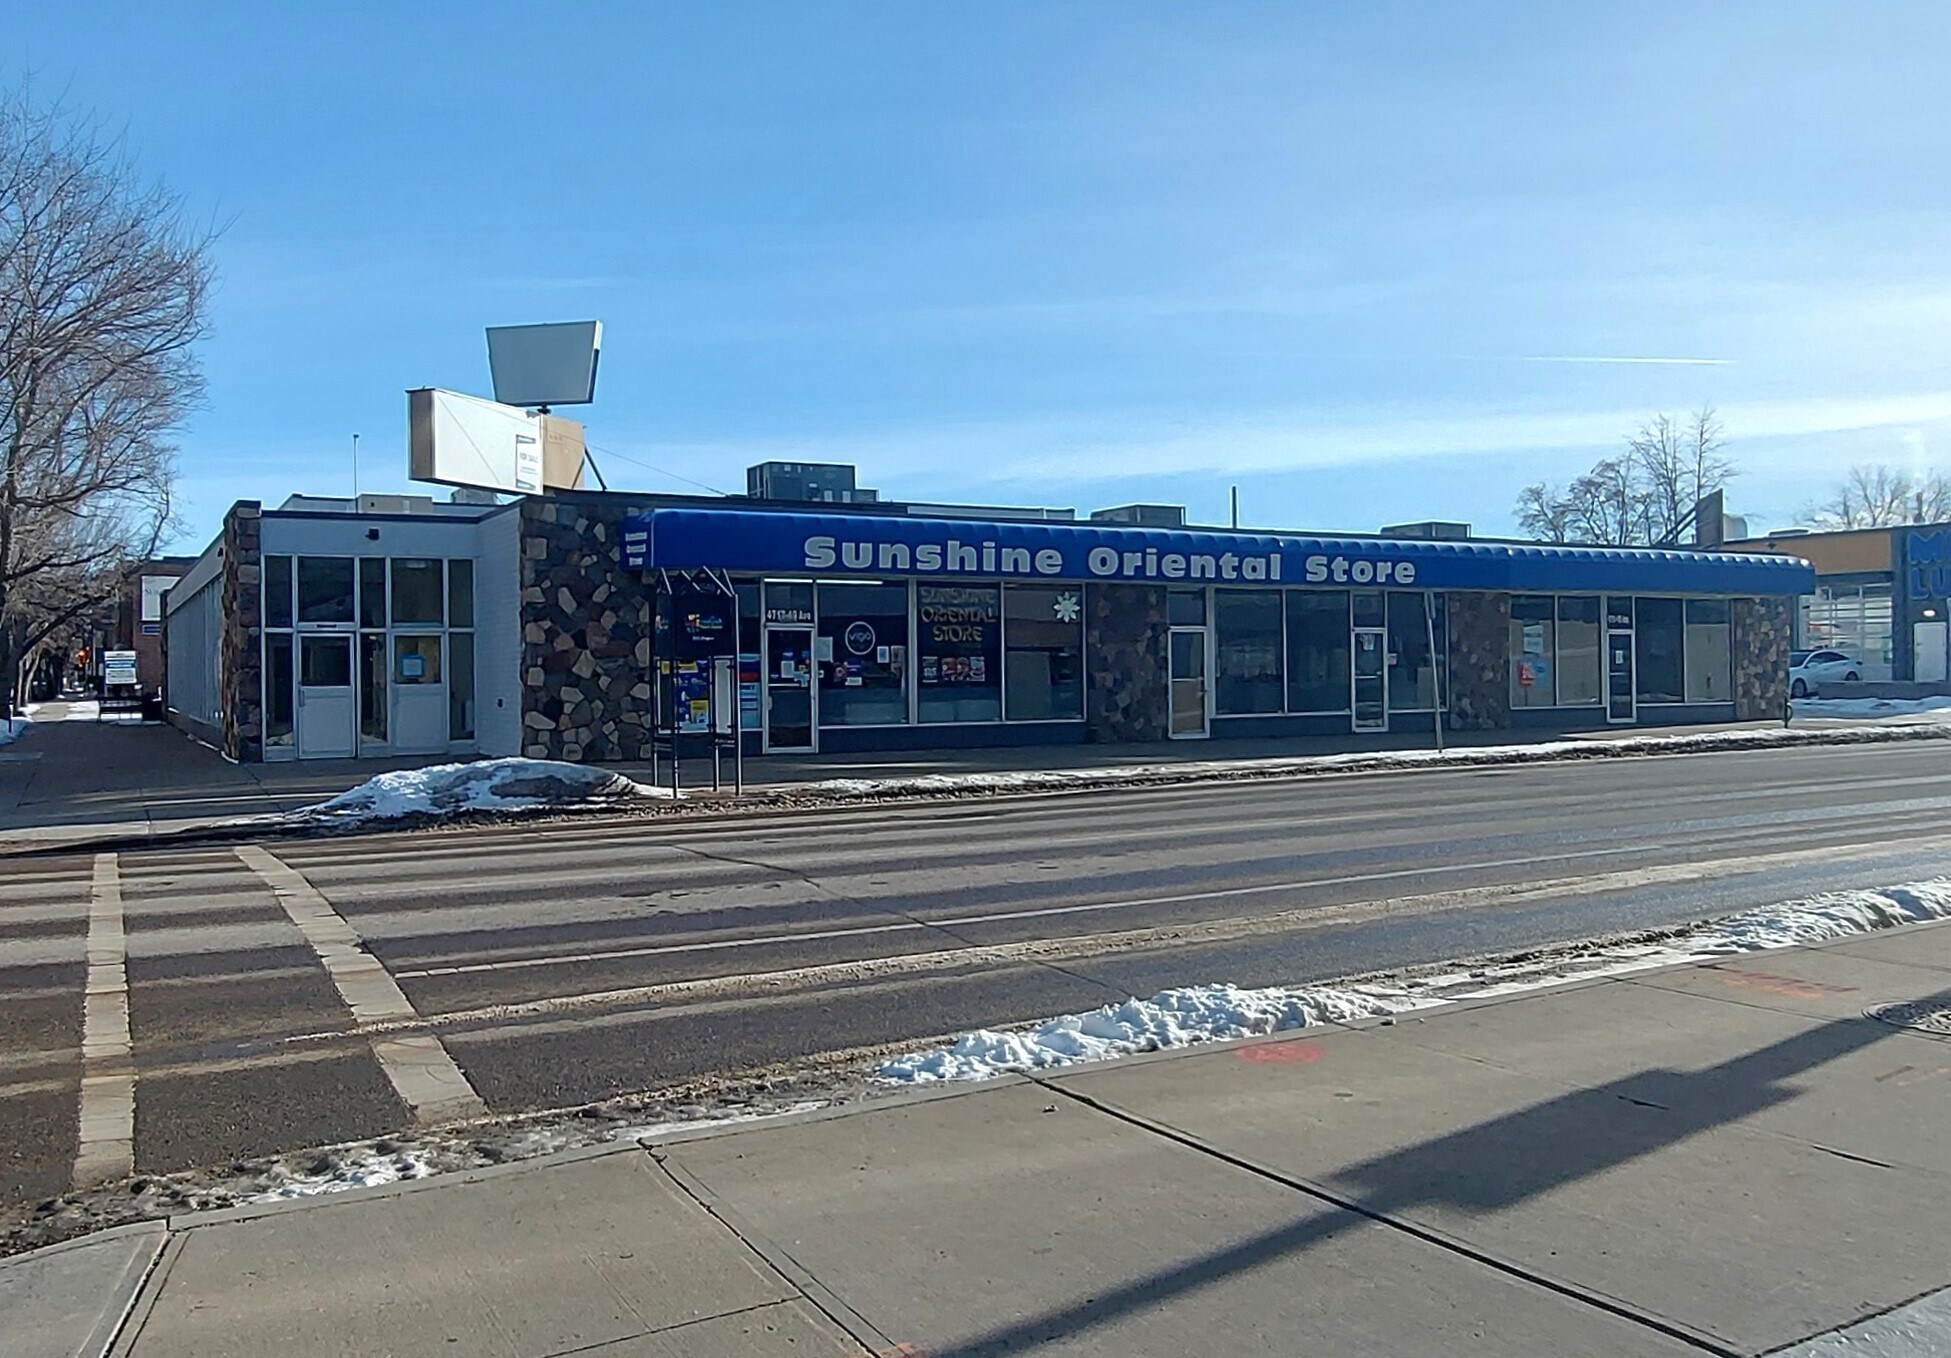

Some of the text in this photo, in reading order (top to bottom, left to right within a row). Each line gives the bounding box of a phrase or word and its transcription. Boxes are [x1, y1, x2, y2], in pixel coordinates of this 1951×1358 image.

[804, 536, 1416, 584] Sunshine Oriental Store
[921, 606, 997, 623] ORIENTAL
[933, 625, 983, 642] STORE
